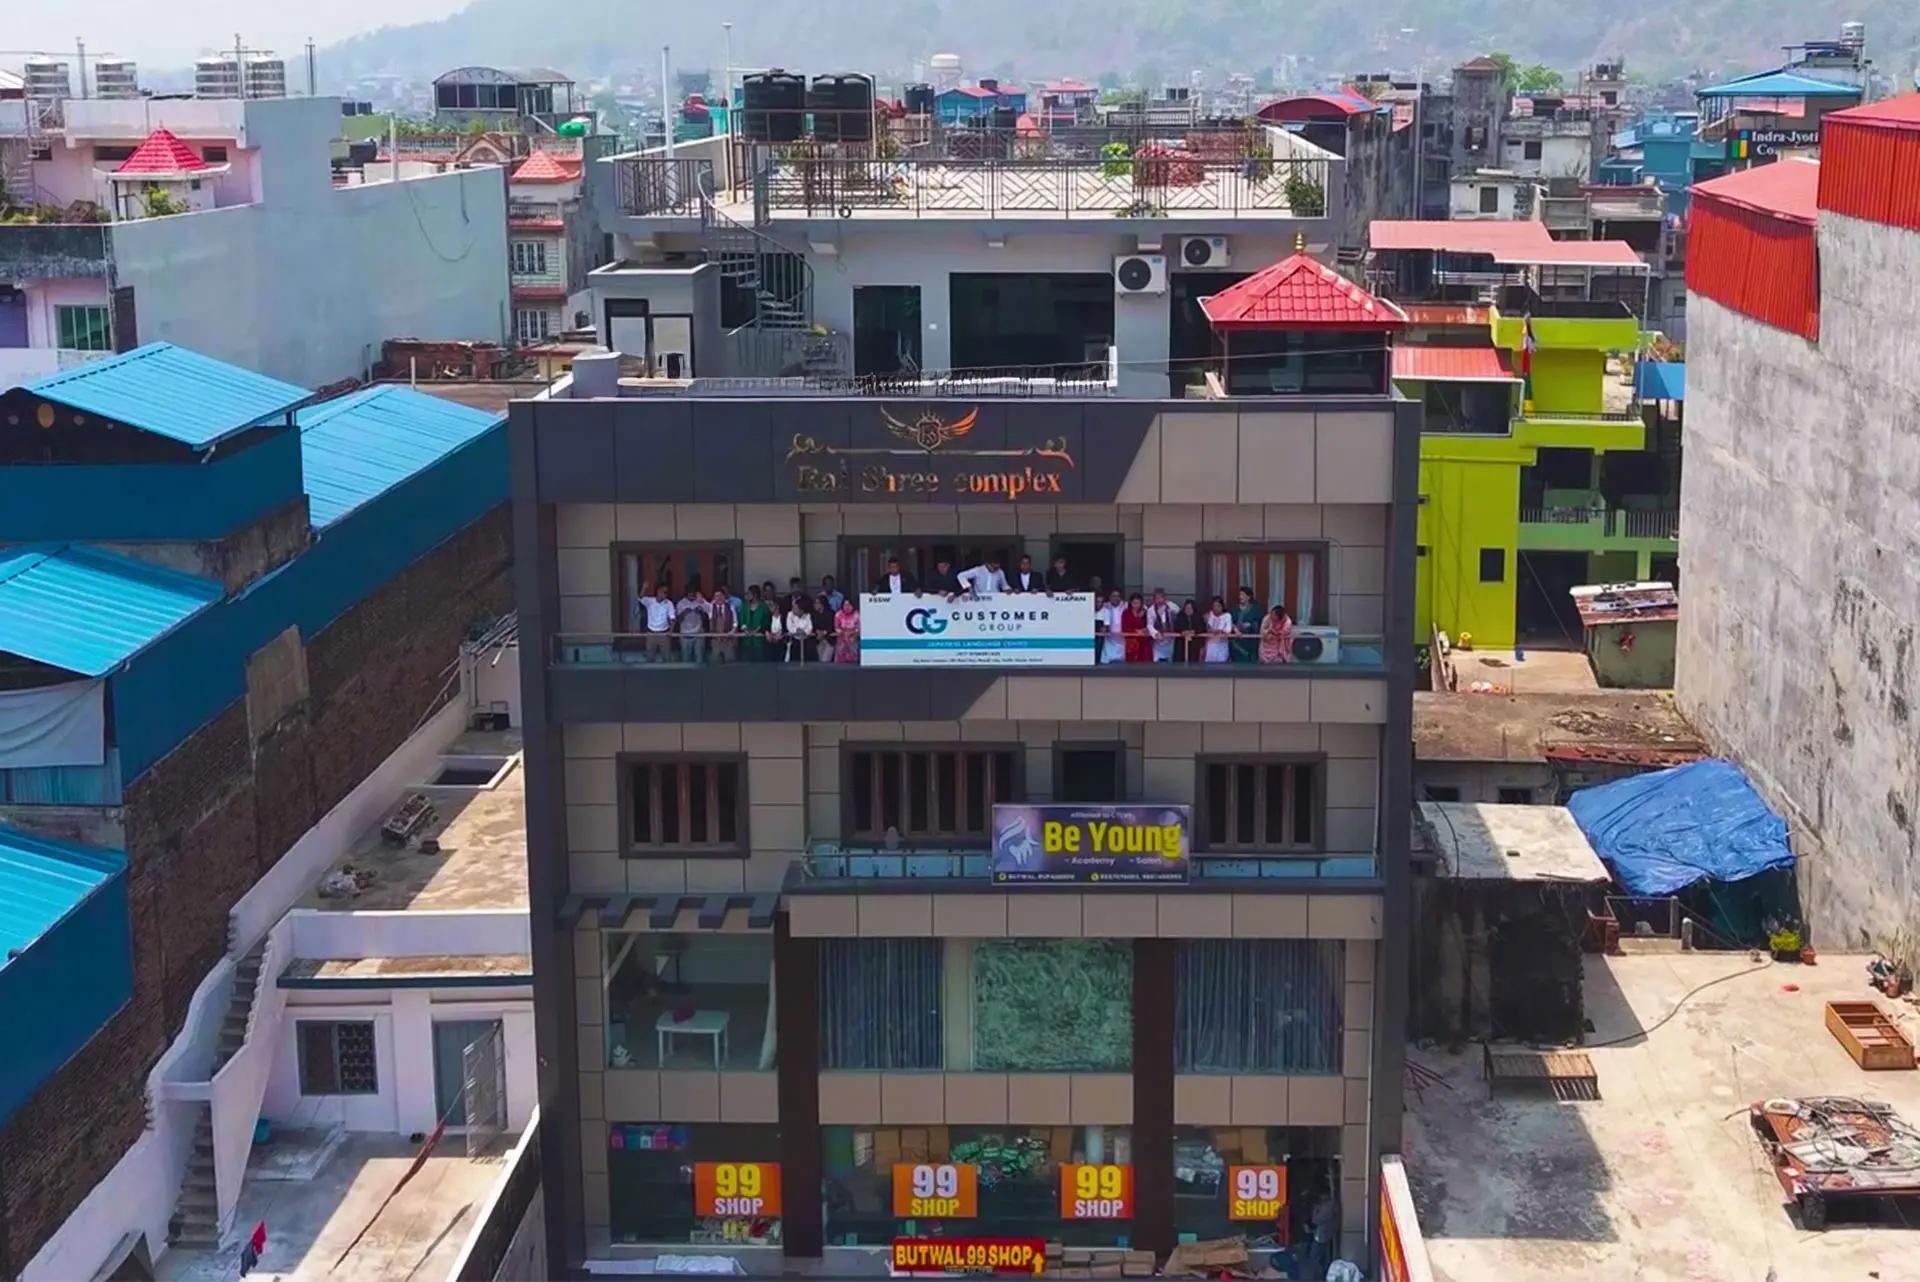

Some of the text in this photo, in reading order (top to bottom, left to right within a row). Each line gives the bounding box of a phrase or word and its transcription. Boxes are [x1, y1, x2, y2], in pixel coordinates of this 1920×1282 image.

[861, 465, 939, 492] Shree
[951, 611, 1050, 621] CUSTOMER
[978, 623, 1023, 632] GROUP
[1044, 821, 1182, 859] Be Young
[1071, 856, 1163, 866] Academy Salon
[716, 1164, 760, 1196] 99
[912, 1165, 957, 1197] 99
[1077, 1165, 1121, 1198] 99
[1237, 1169, 1278, 1199] 99
[715, 1197, 764, 1215] SHOP
[911, 1198, 959, 1216] SHOP
[1075, 1199, 1124, 1217] SHOP
[1235, 1199, 1280, 1217] SHOP
[896, 1245, 1033, 1266] BUTWAL 99 SHOP
